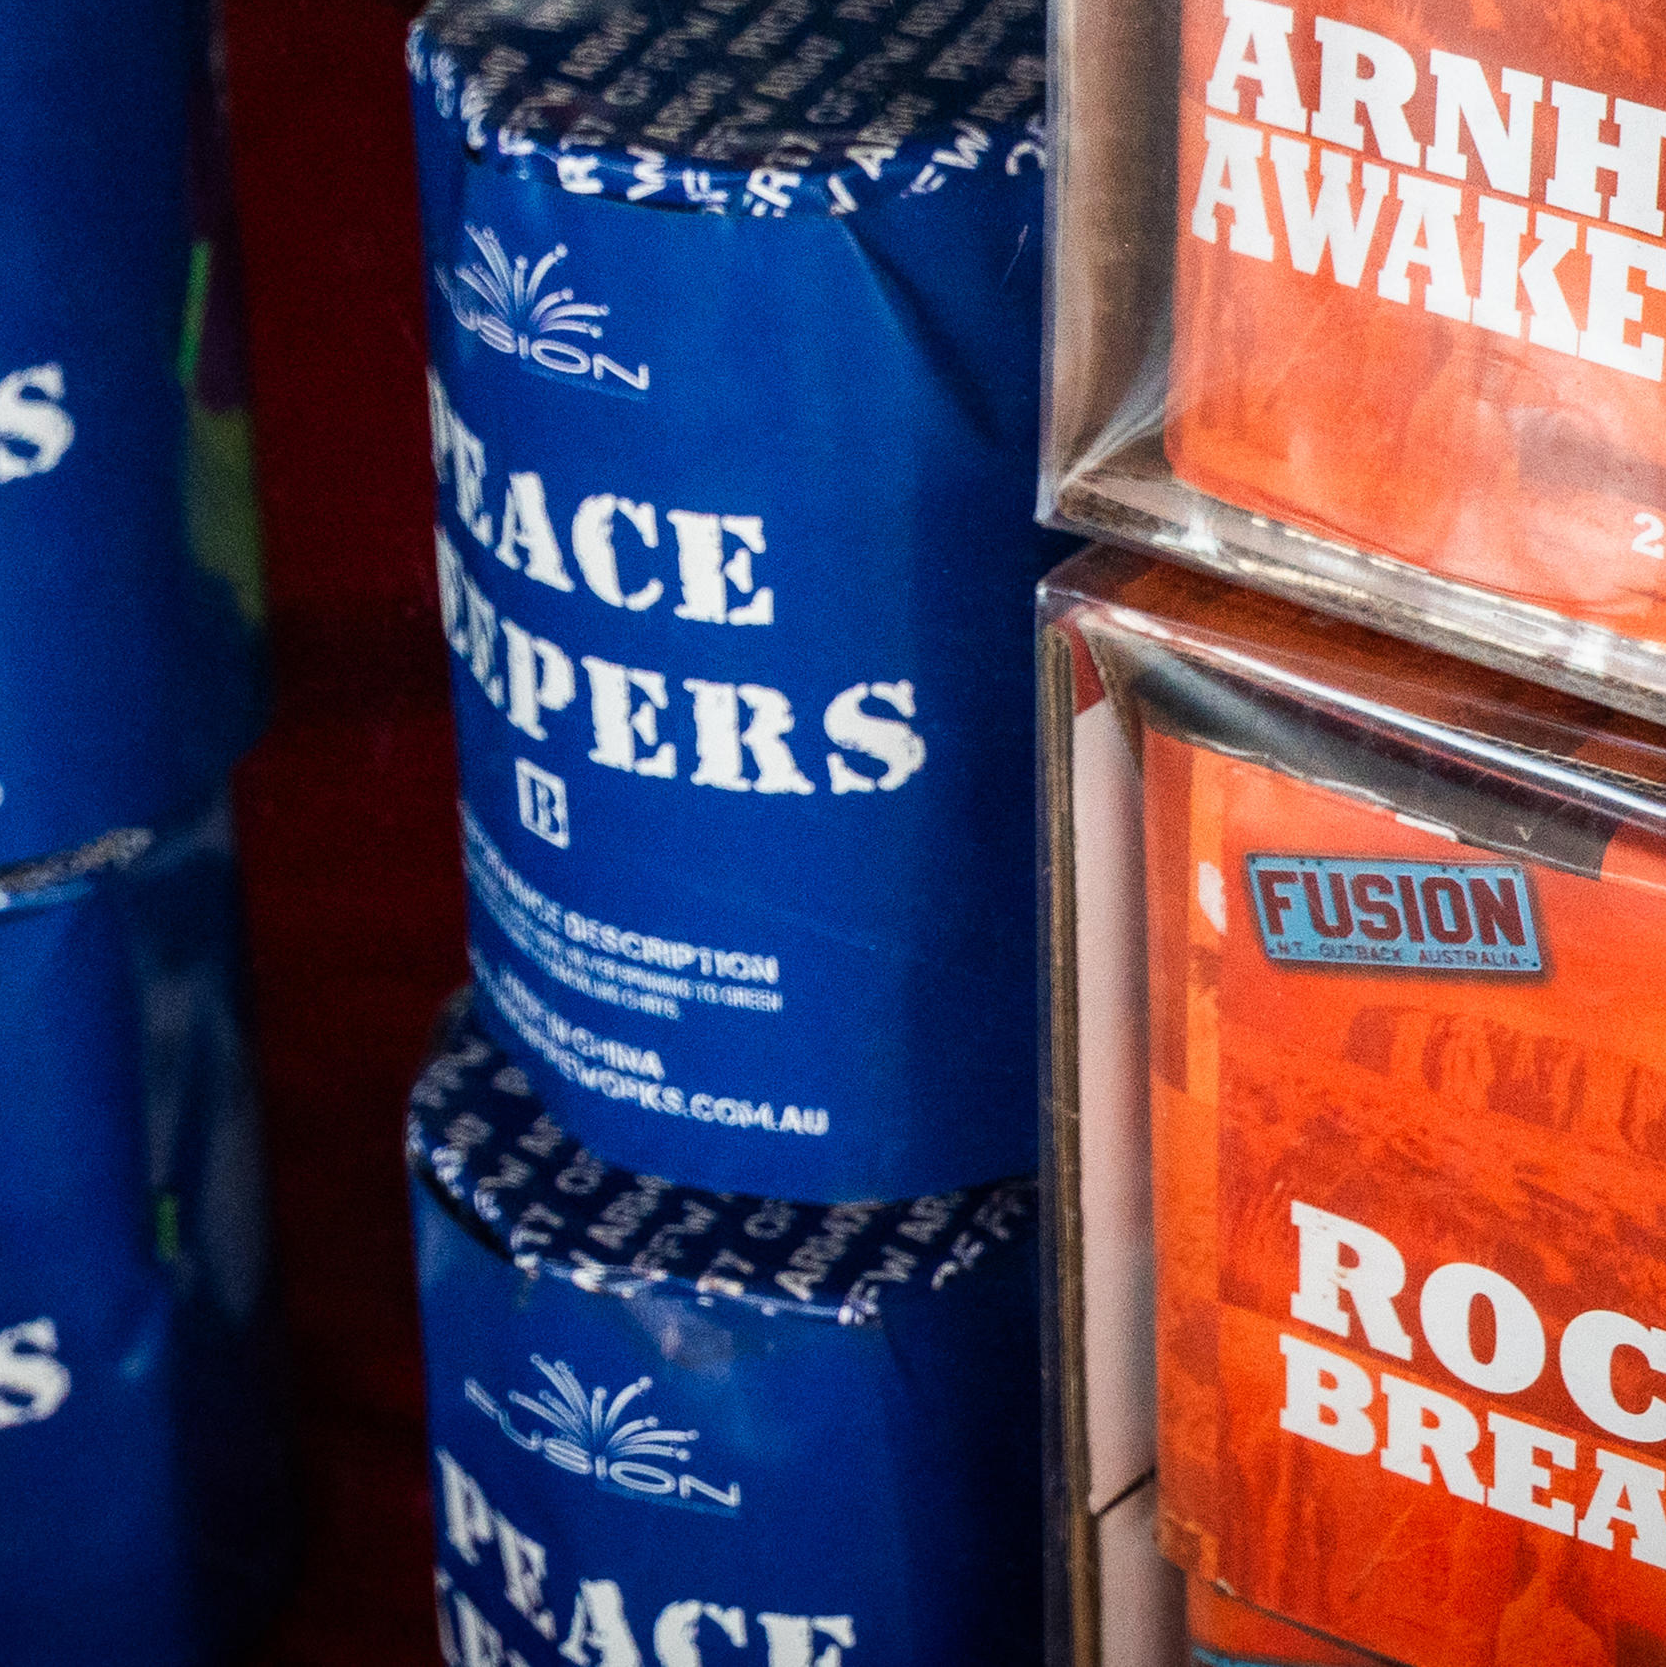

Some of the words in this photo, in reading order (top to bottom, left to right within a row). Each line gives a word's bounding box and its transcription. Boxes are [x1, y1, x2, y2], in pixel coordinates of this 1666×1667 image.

[1257, 868, 1527, 947] FUSION
[564, 910, 780, 984] DESCRIPTION
[1318, 942, 1402, 963] OUTBACK
[1418, 948, 1520, 968] AUSTRALIA
[570, 1026, 666, 1082] CHINA
[463, 1374, 742, 1509] FUSION
